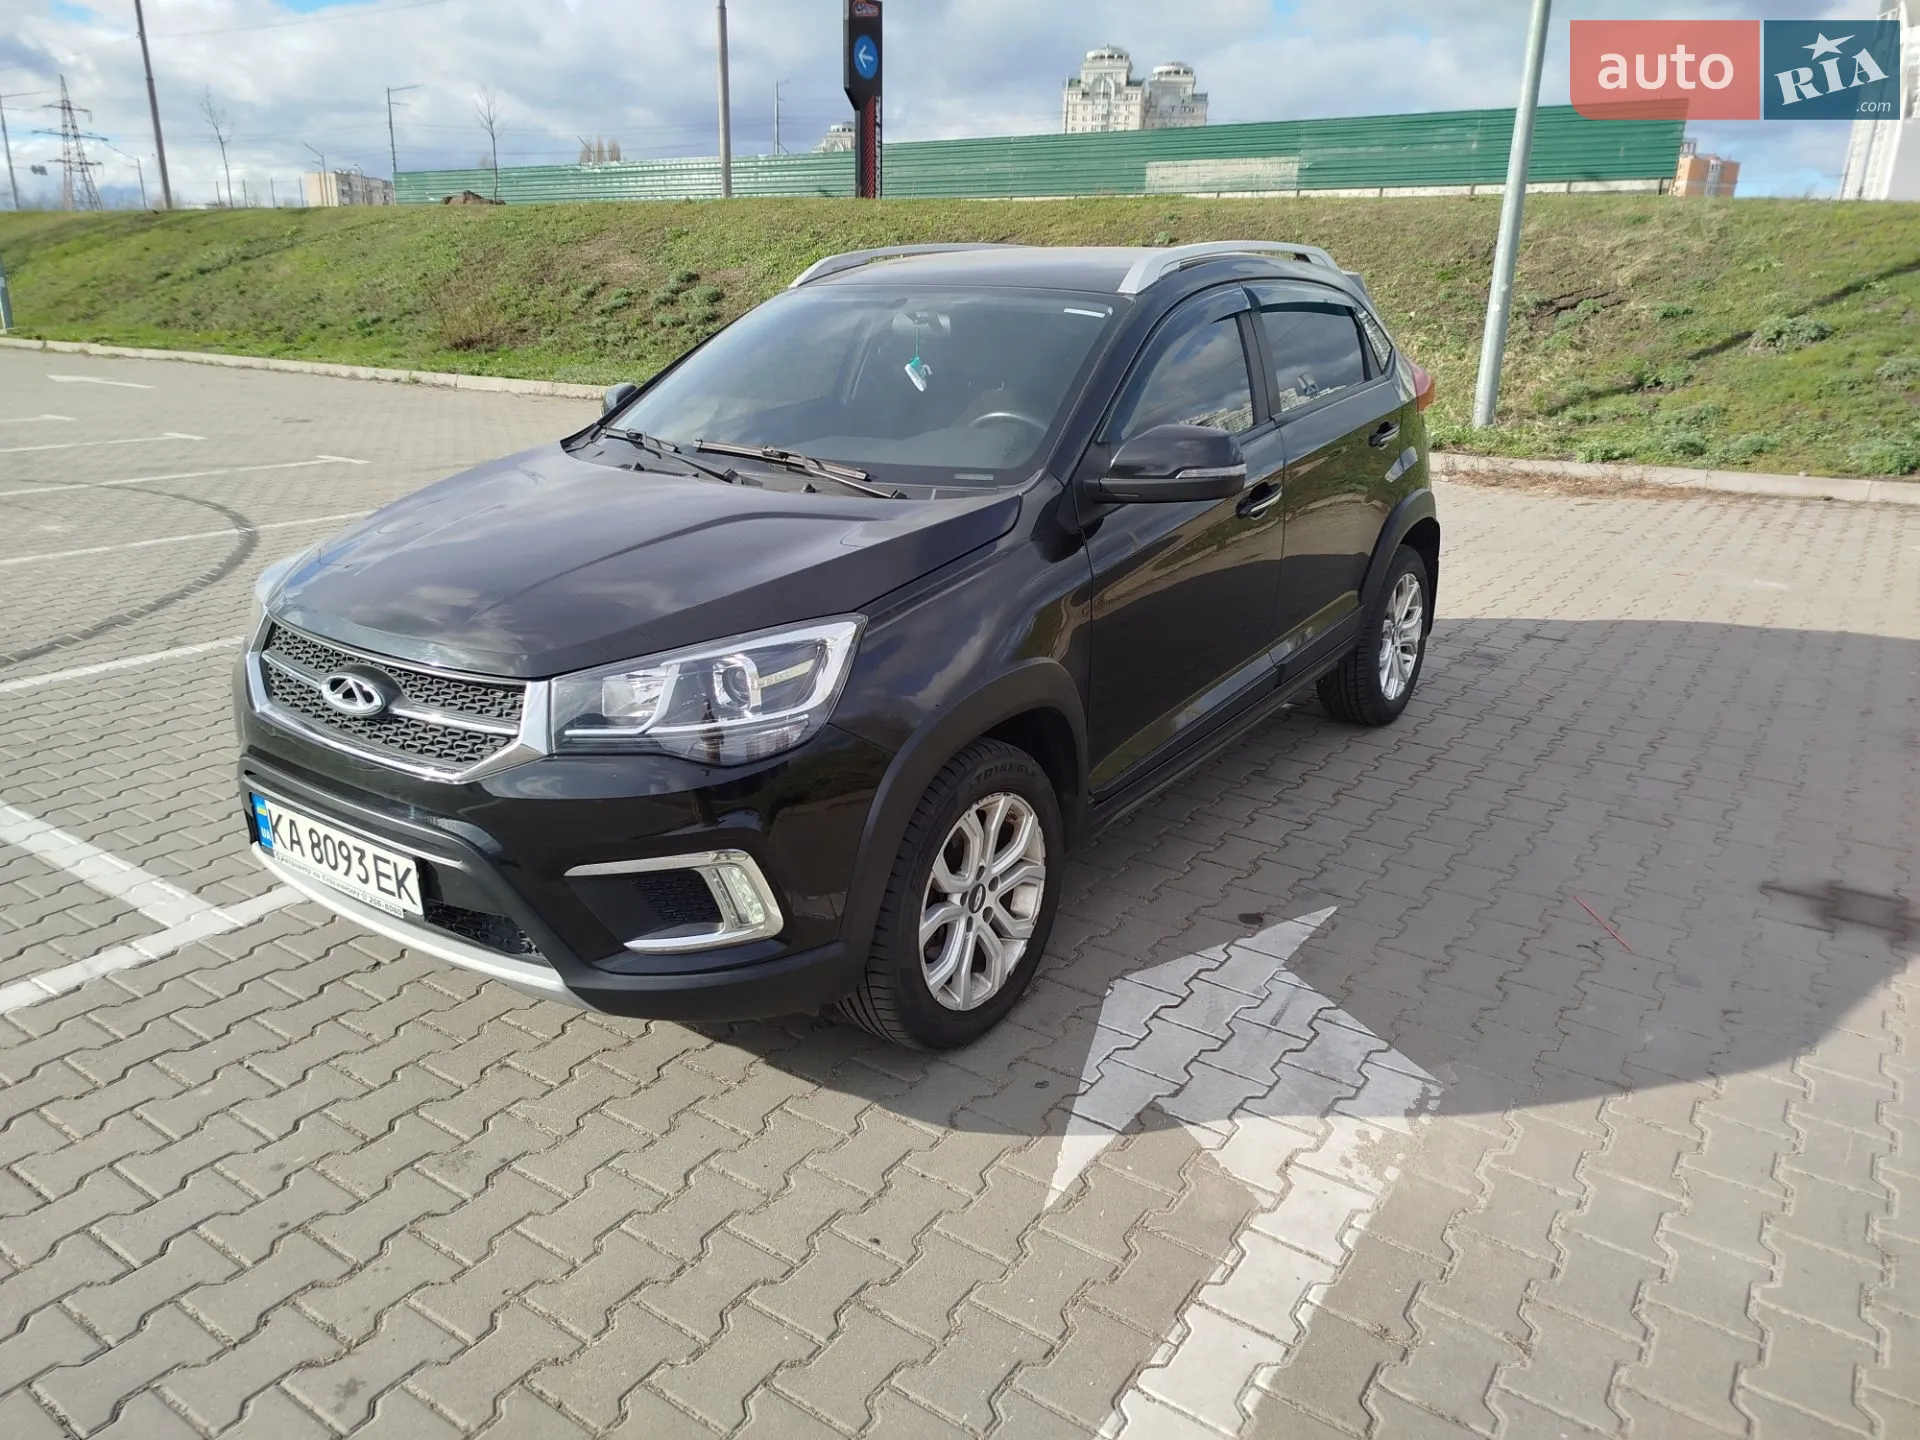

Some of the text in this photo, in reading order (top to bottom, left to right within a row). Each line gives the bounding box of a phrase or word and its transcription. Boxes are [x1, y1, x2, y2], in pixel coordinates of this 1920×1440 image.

[260, 826, 272, 841] UA
[268, 808, 418, 906] KA 8093 EK
